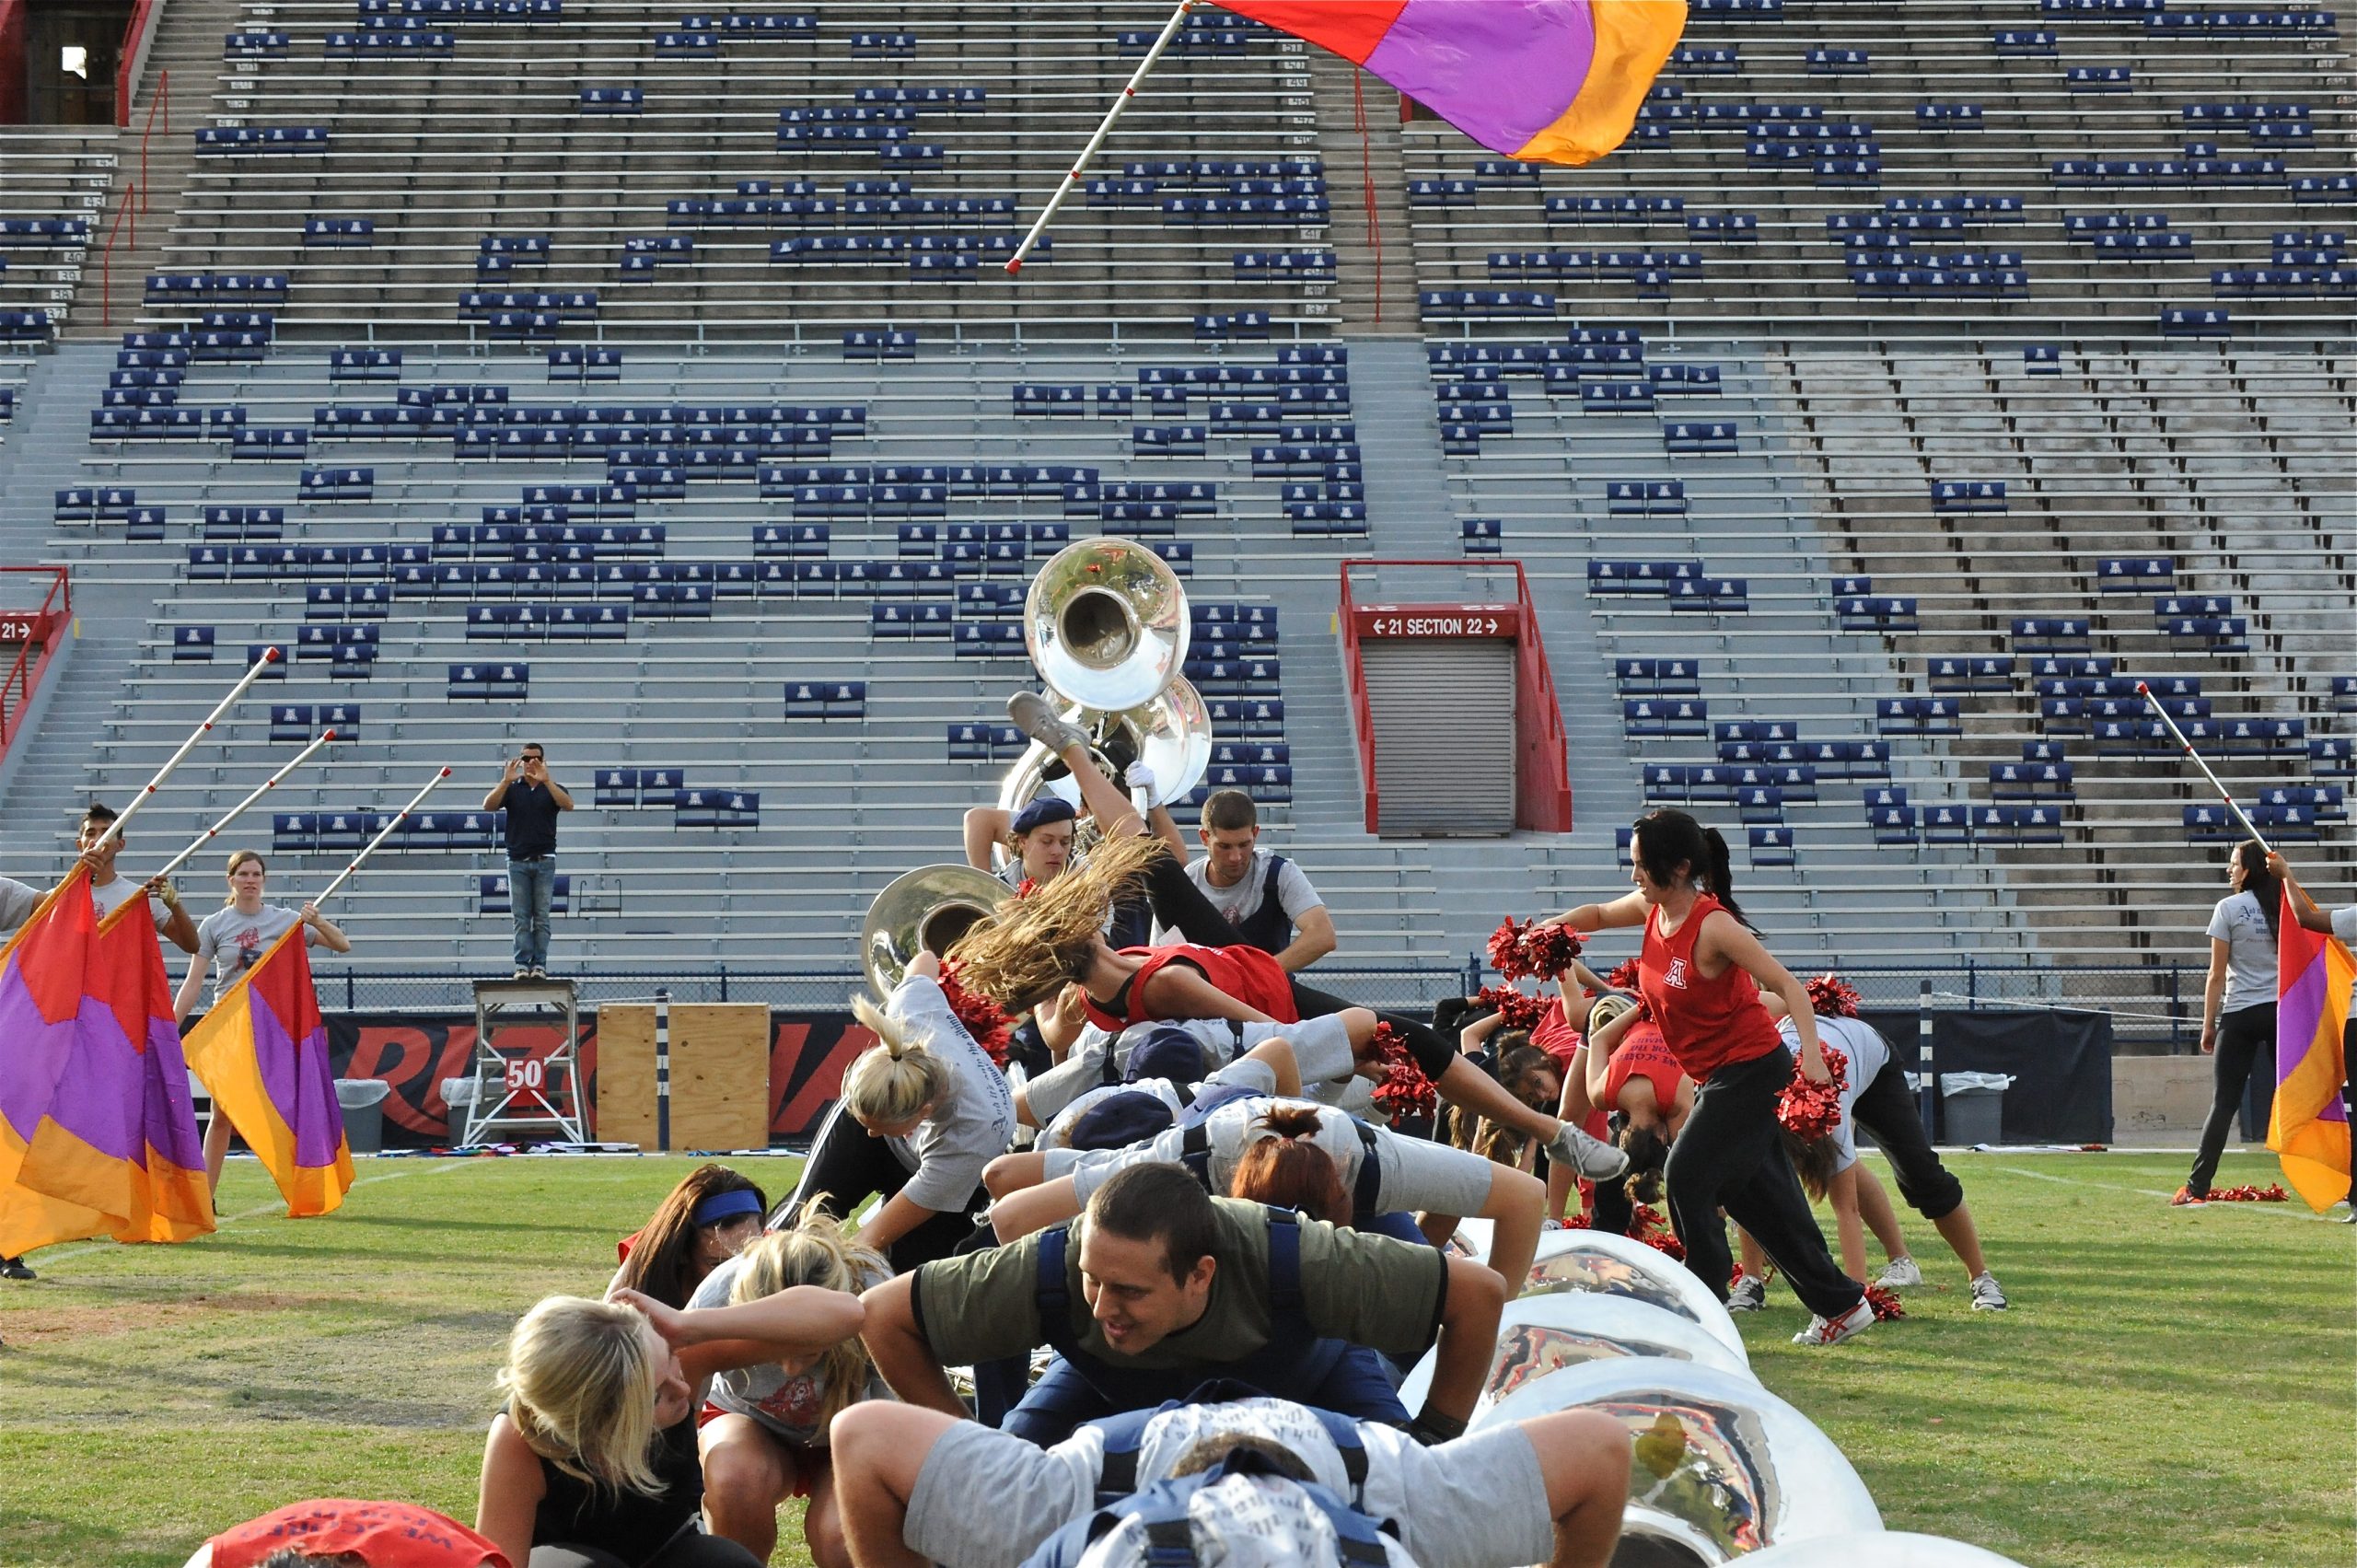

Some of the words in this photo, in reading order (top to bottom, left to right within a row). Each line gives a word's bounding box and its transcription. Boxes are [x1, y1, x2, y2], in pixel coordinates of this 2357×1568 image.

[2, 622, 16, 638] 21
[1388, 618, 1402, 634] 21
[1407, 618, 1462, 634] SECTION
[1467, 618, 1483, 634] 22
[1664, 957, 1687, 989] A
[507, 1060, 541, 1087] 50
